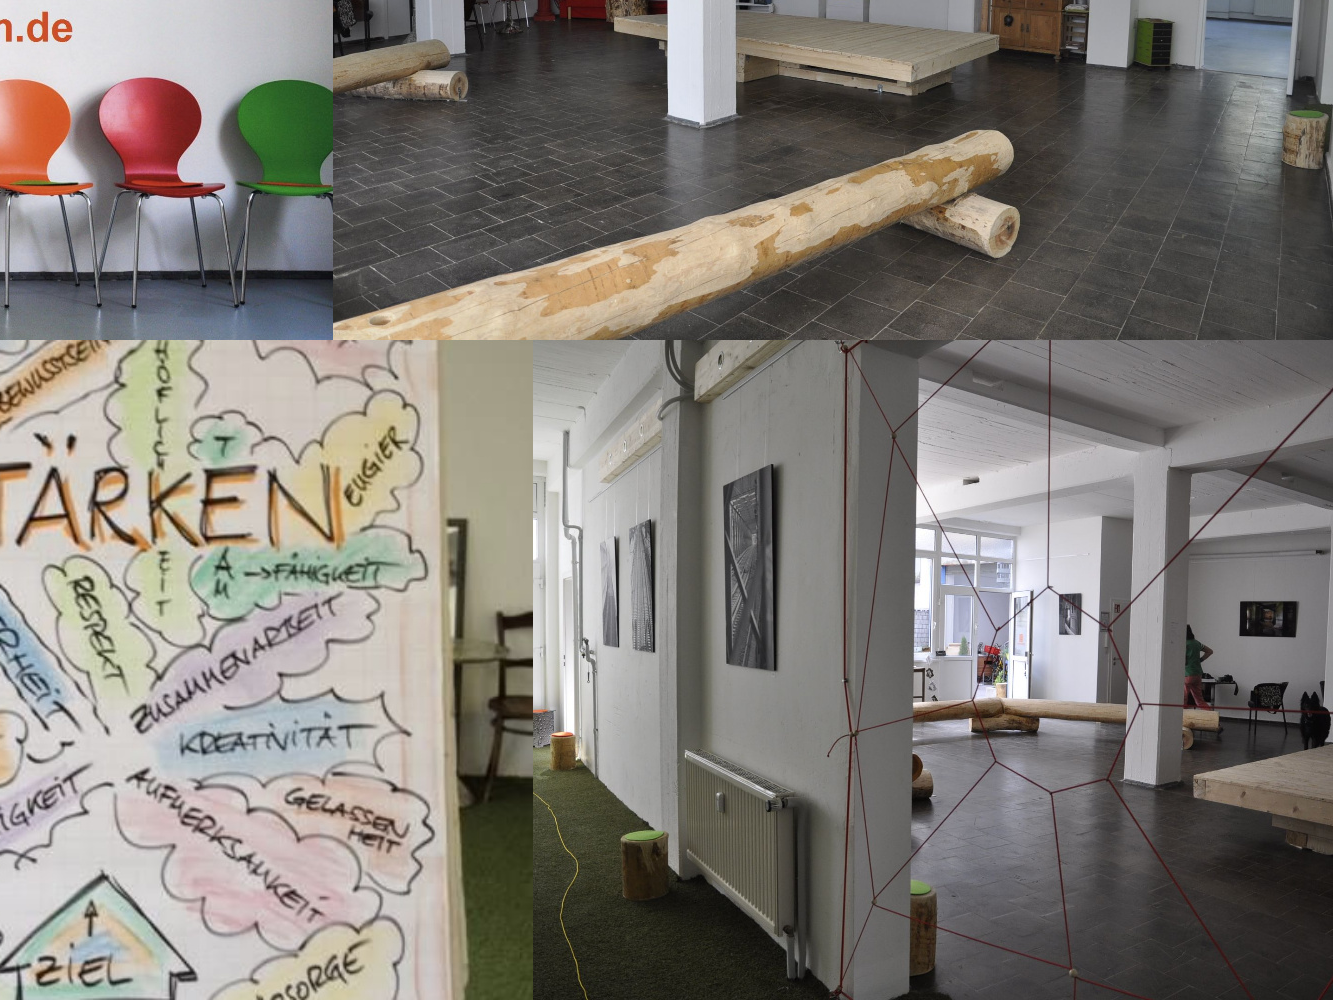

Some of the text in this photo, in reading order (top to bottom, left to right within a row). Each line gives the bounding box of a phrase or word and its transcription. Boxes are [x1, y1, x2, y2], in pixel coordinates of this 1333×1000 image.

[69, 575, 131, 697] RESPEKT
[130, 591, 344, 734] ZUSAMMENARBEIT
[179, 711, 378, 757] KREATIVITÄT
[284, 787, 410, 839] GELASSEN
[348, 828, 401, 854] HEIT
[126, 768, 331, 923] AUFMERKSAMKEIT
[35, 943, 133, 987] ZIEL
[256, 939, 371, 1000] SORGE
